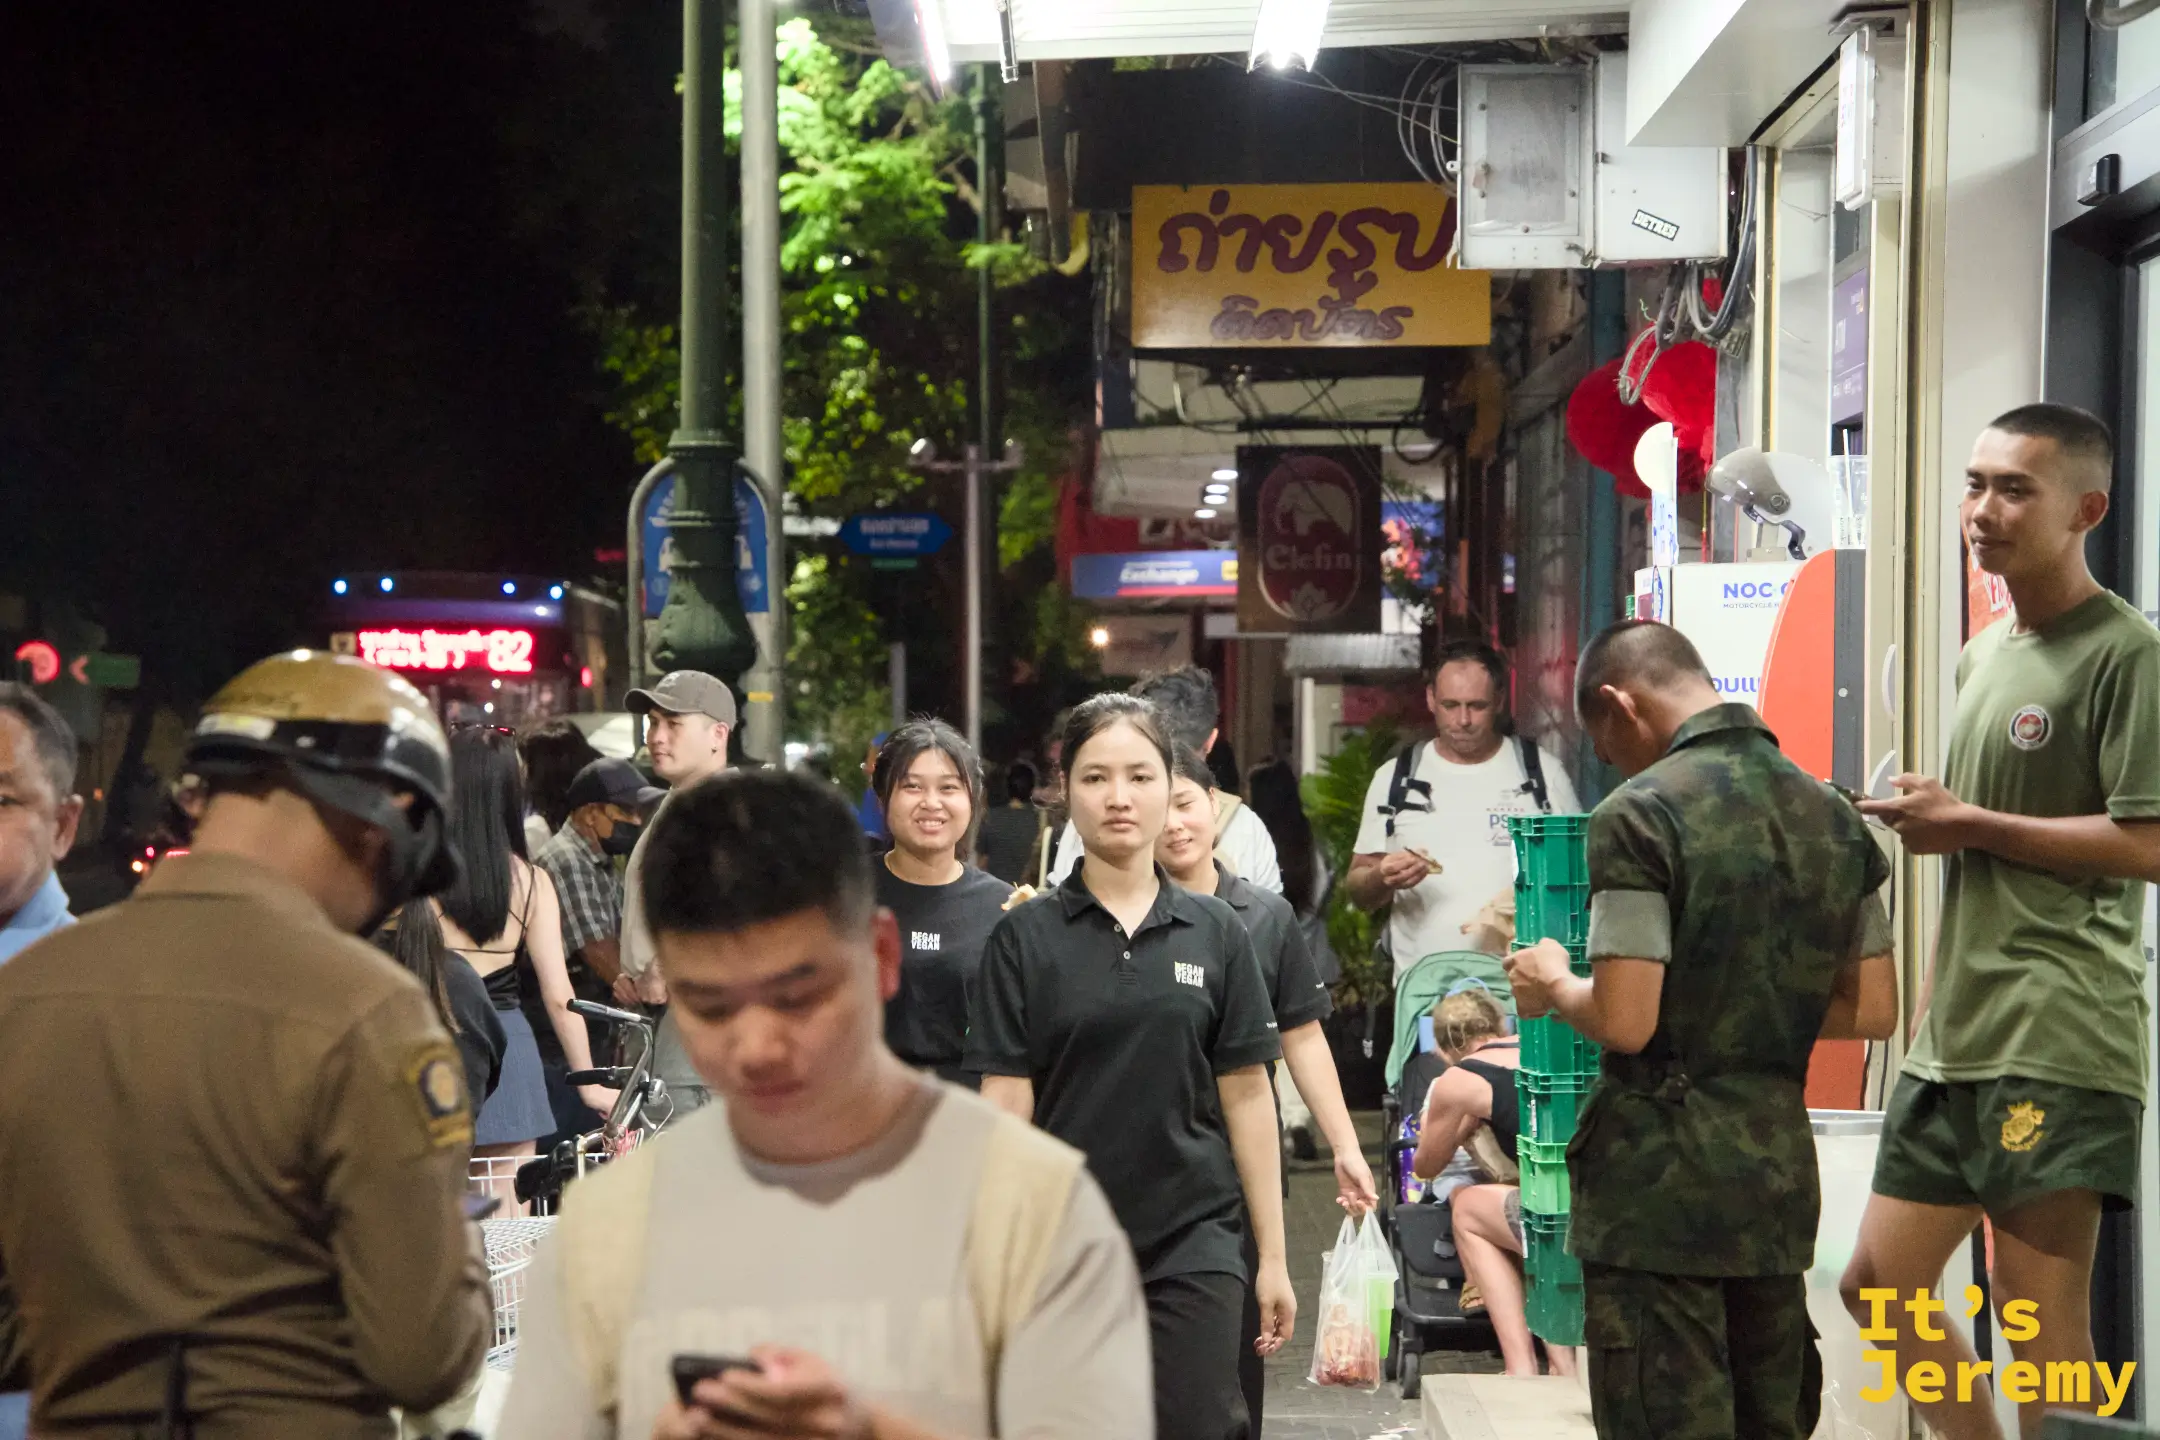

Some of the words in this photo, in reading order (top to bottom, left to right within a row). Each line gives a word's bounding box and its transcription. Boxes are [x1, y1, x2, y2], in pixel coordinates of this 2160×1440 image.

[1158, 189, 1458, 304] ถ่ายรูป
[1723, 582, 1773, 599] NOC
[488, 630, 532, 672] 82
[911, 930, 941, 941] BEGAN
[911, 939, 940, 951] VEGAN
[1174, 961, 1205, 977] BEGAN
[1174, 971, 1204, 988] VEGAN
